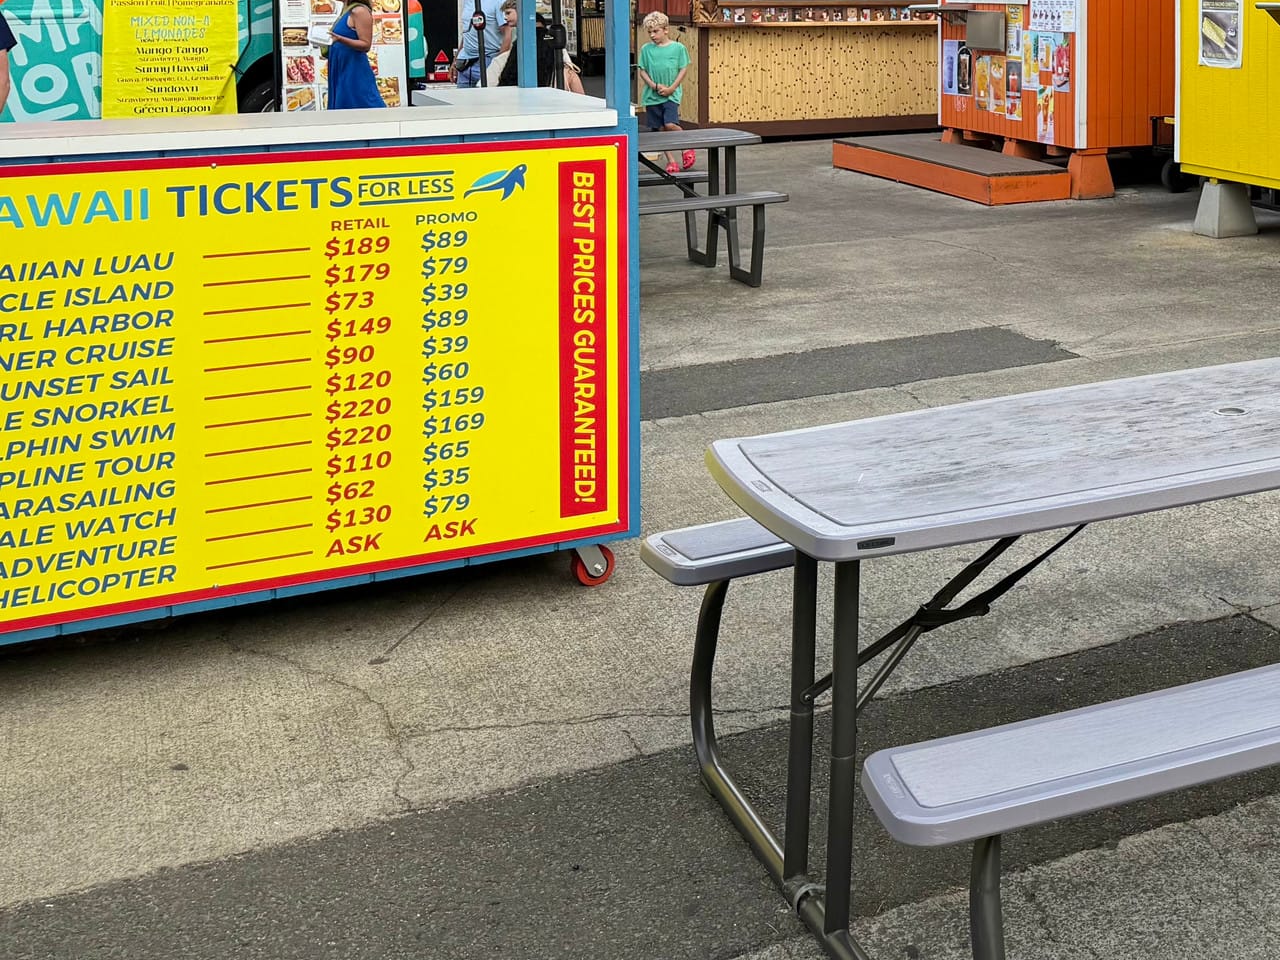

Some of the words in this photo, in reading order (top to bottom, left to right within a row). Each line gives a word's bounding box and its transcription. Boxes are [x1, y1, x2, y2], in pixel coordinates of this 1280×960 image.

[130, 15, 169, 26] MIXED
[135, 28, 206, 39] LEMONADES
[136, 46, 172, 56] Mango
[176, 46, 208, 56] Tango
[146, 85, 199, 93] Sundown
[134, 105, 168, 114] Green
[170, 105, 211, 114] Lagoon
[166, 176, 353, 218] TICKETS
[359, 180, 400, 199] FOR
[408, 177, 454, 195] LESS
[573, 171, 594, 232] BEST
[331, 217, 390, 231] RETAIL
[415, 211, 478, 225] PROMO
[325, 236, 391, 260] $189
[421, 230, 468, 252] $89
[93, 252, 175, 276] LUAU
[325, 263, 391, 288] $179
[421, 256, 468, 279] $79
[573, 238, 595, 324] PRICES
[64, 281, 174, 307] ISLAND
[325, 291, 374, 315] $73
[421, 283, 468, 306] $39
[43, 309, 174, 338] HARBOR
[326, 316, 391, 342] $149
[421, 309, 469, 332] $89
[65, 337, 175, 366] CRUISE
[325, 345, 375, 369] $90
[422, 335, 469, 359] $39
[1, 373, 104, 401] UNSET
[109, 367, 174, 390] SAIL
[326, 370, 391, 396] $120
[422, 361, 469, 385] $60
[31, 395, 174, 428] SNORKEL
[325, 396, 391, 424] $220
[422, 386, 484, 412] $159
[422, 412, 484, 439] $169
[574, 329, 596, 503] GUARANTEED!
[0, 433, 82, 461] PHIN
[90, 422, 176, 450] SWIM
[326, 423, 391, 451] $220
[95, 451, 176, 478] TOUR
[326, 451, 391, 478] $110
[422, 440, 469, 465] $65
[423, 466, 470, 491] $35
[326, 479, 375, 506] $62
[326, 504, 391, 532] $130
[423, 493, 470, 518] $79
[65, 507, 176, 540] WATCH
[423, 518, 478, 542] ASK
[325, 533, 383, 557] ASK
